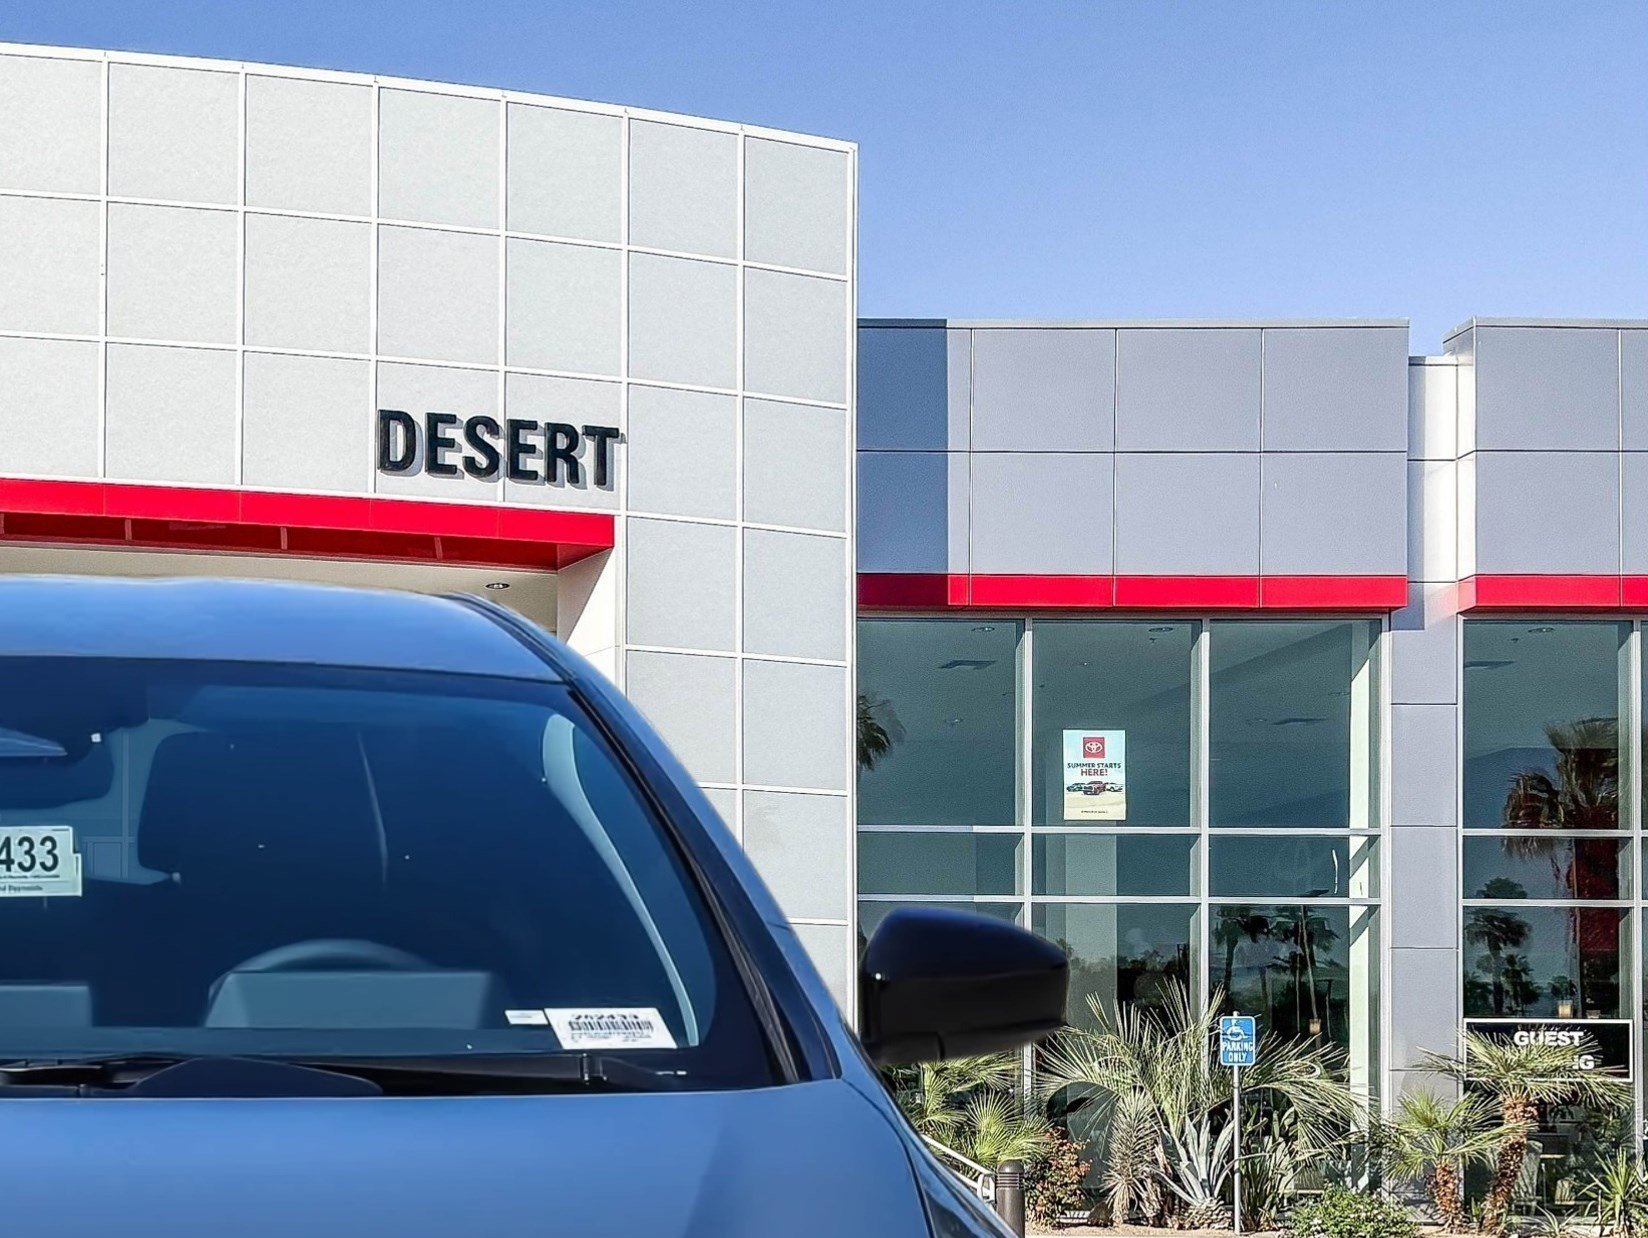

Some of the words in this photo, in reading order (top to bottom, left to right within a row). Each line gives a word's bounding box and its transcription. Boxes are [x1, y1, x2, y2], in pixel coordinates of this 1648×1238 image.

[377, 409, 620, 487] DESERT
[1080, 768, 1108, 776] HERE!
[1513, 1031, 1584, 1046] GUEST
[1222, 1041, 1253, 1051] PARKING
[1228, 1051, 1247, 1062] ONLY
